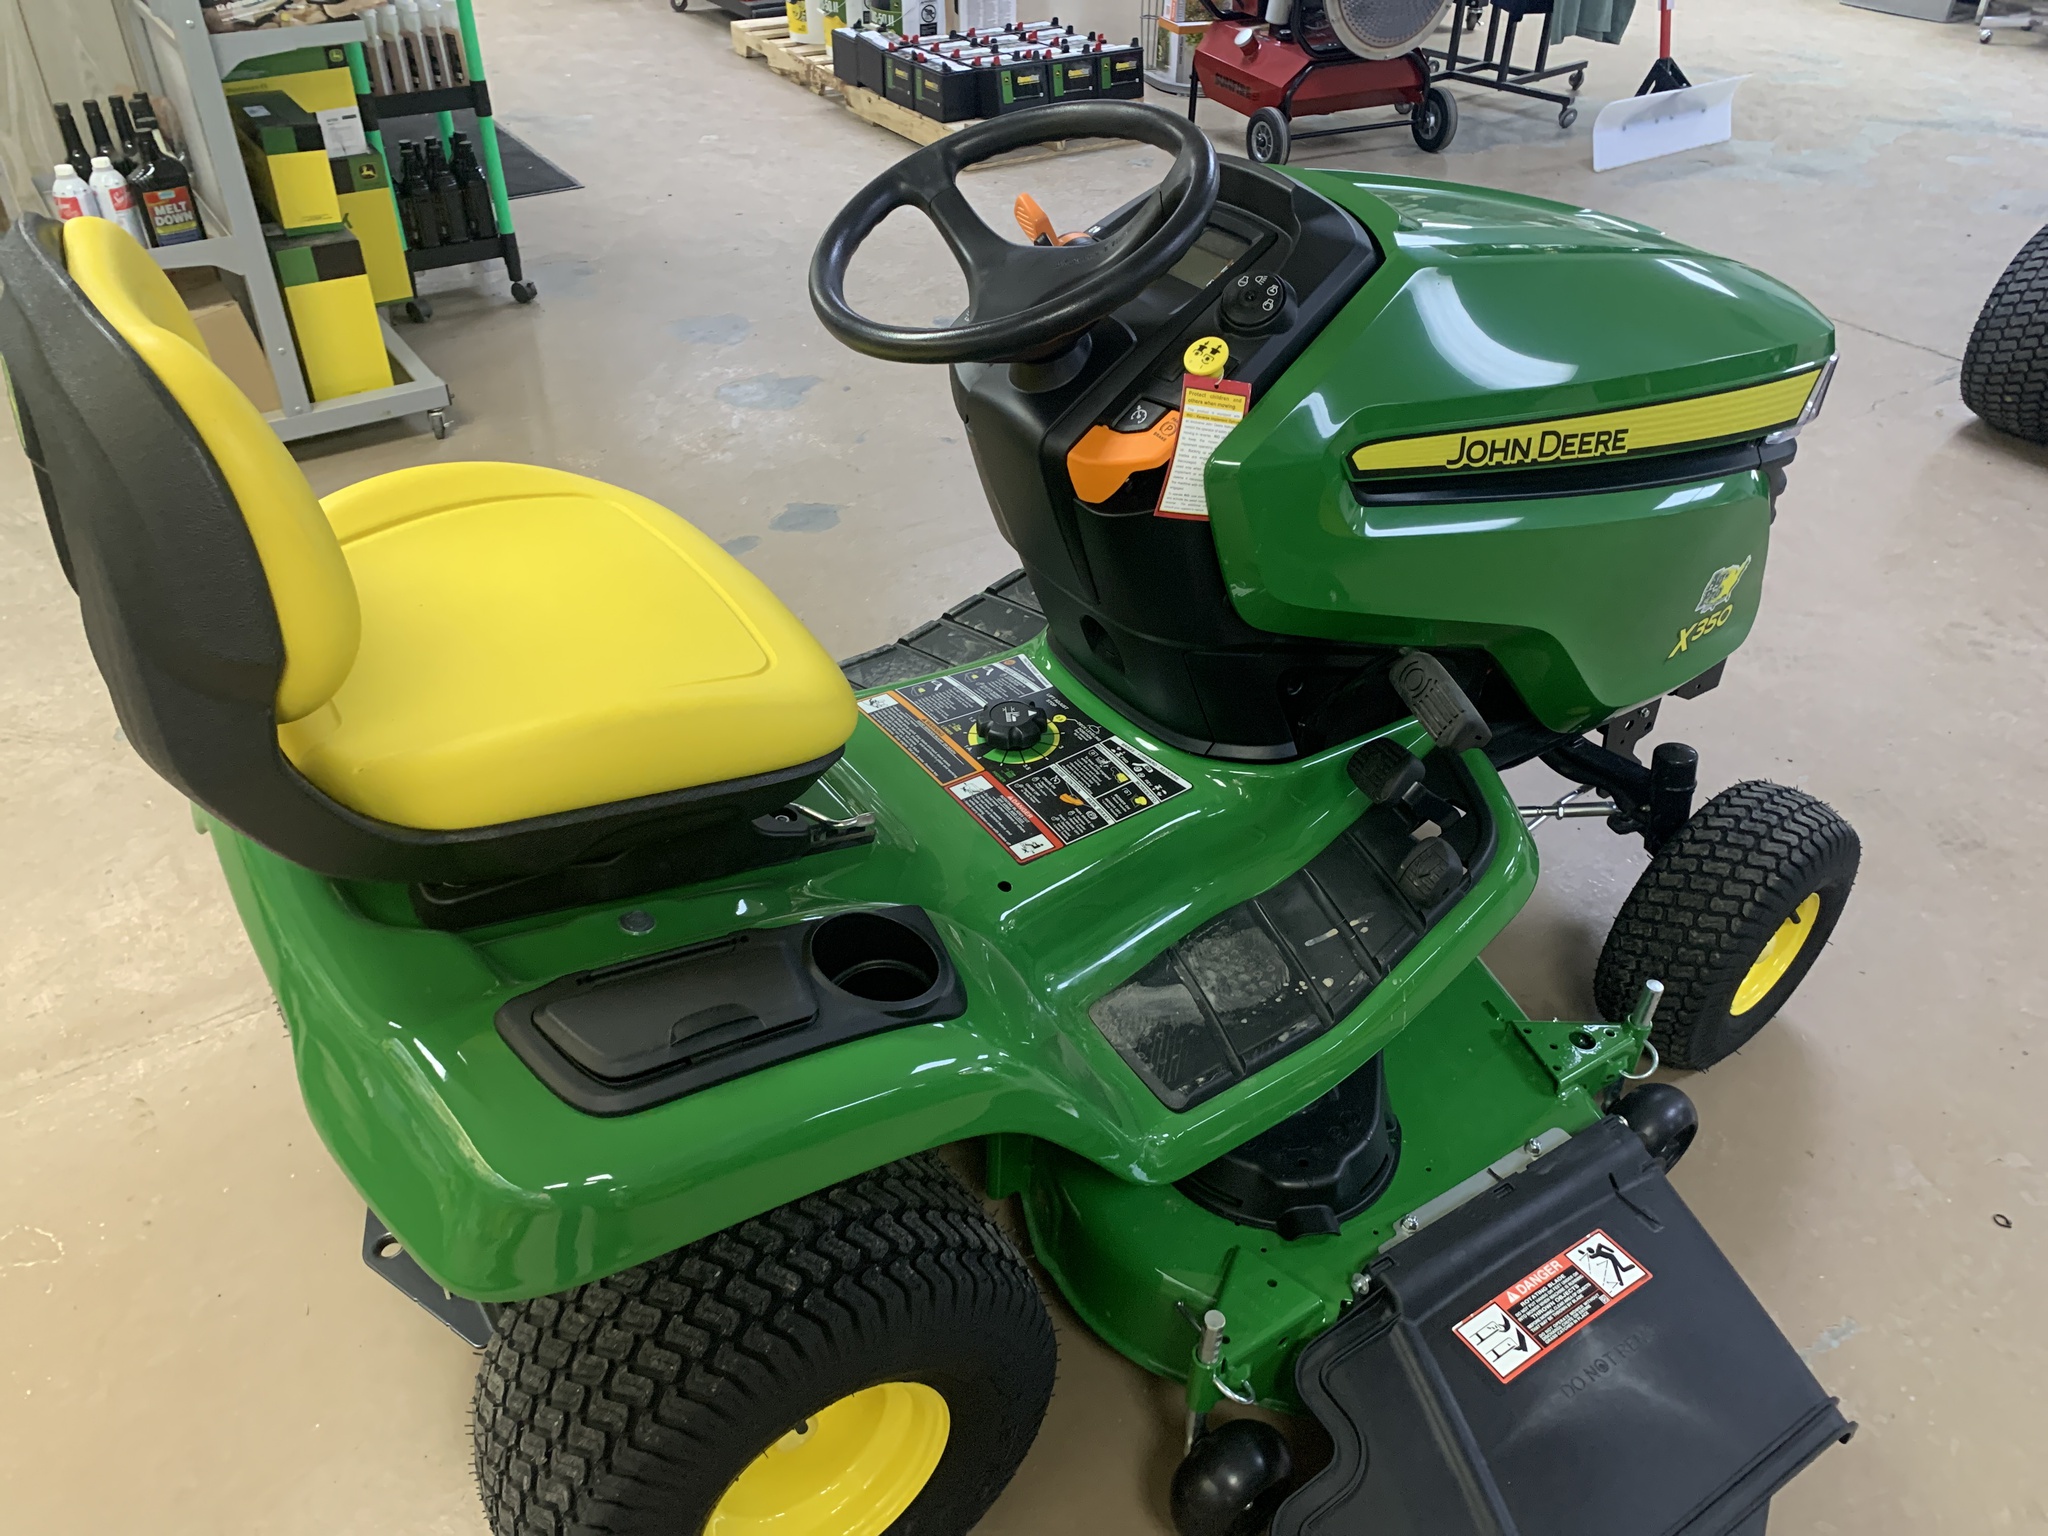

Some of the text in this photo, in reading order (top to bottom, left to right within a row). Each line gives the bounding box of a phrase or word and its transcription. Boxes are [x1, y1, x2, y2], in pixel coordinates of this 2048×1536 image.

[154, 201, 187, 216] MELT
[154, 211, 193, 226] DOWN
[1210, 393, 1229, 401] children
[1446, 429, 1629, 466] JOHN DEERE
[1667, 604, 1733, 659] X350
[1010, 798, 1034, 818] DANGER
[1515, 1259, 1563, 1296] DANGER
[1519, 1273, 1566, 1307] ROTATING BLADE
[1530, 1282, 1580, 1319] THROWN OBJECTS
[1559, 1376, 1586, 1399] DO
[1583, 1351, 1617, 1382] NOT
